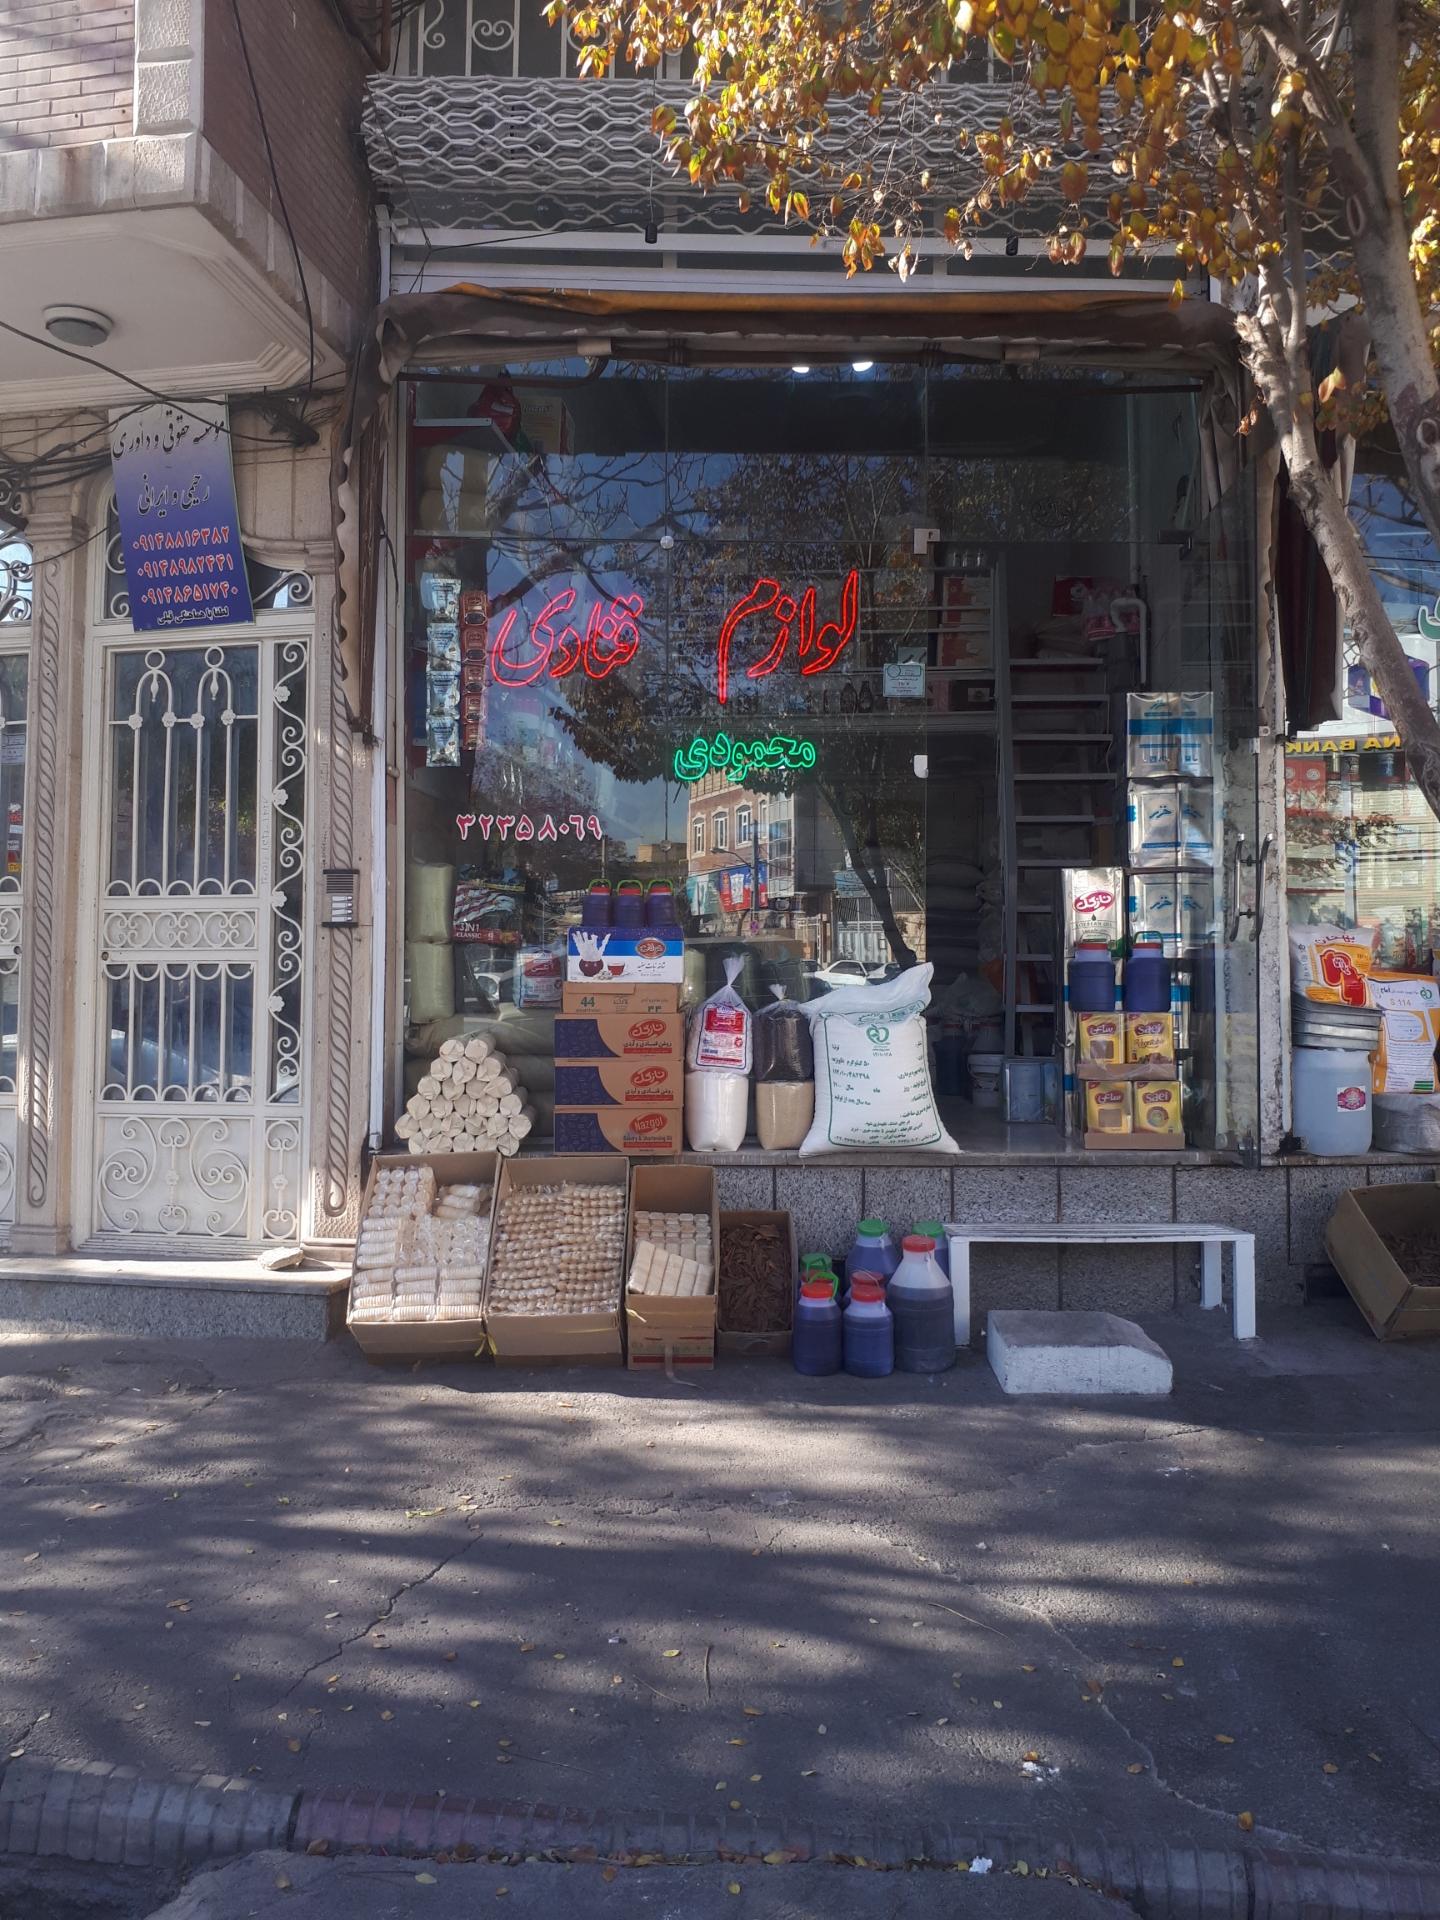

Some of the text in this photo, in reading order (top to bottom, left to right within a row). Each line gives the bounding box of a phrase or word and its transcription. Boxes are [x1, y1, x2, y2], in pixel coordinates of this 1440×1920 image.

[112, 430, 150, 459] داوری
[154, 434, 159, 448] و
[163, 409, 190, 453] حقوقی
[171, 490, 179, 506] و
[488, 587, 644, 689] قنادی
[716, 568, 859, 703] لوازم
[673, 731, 817, 783] محمودی
